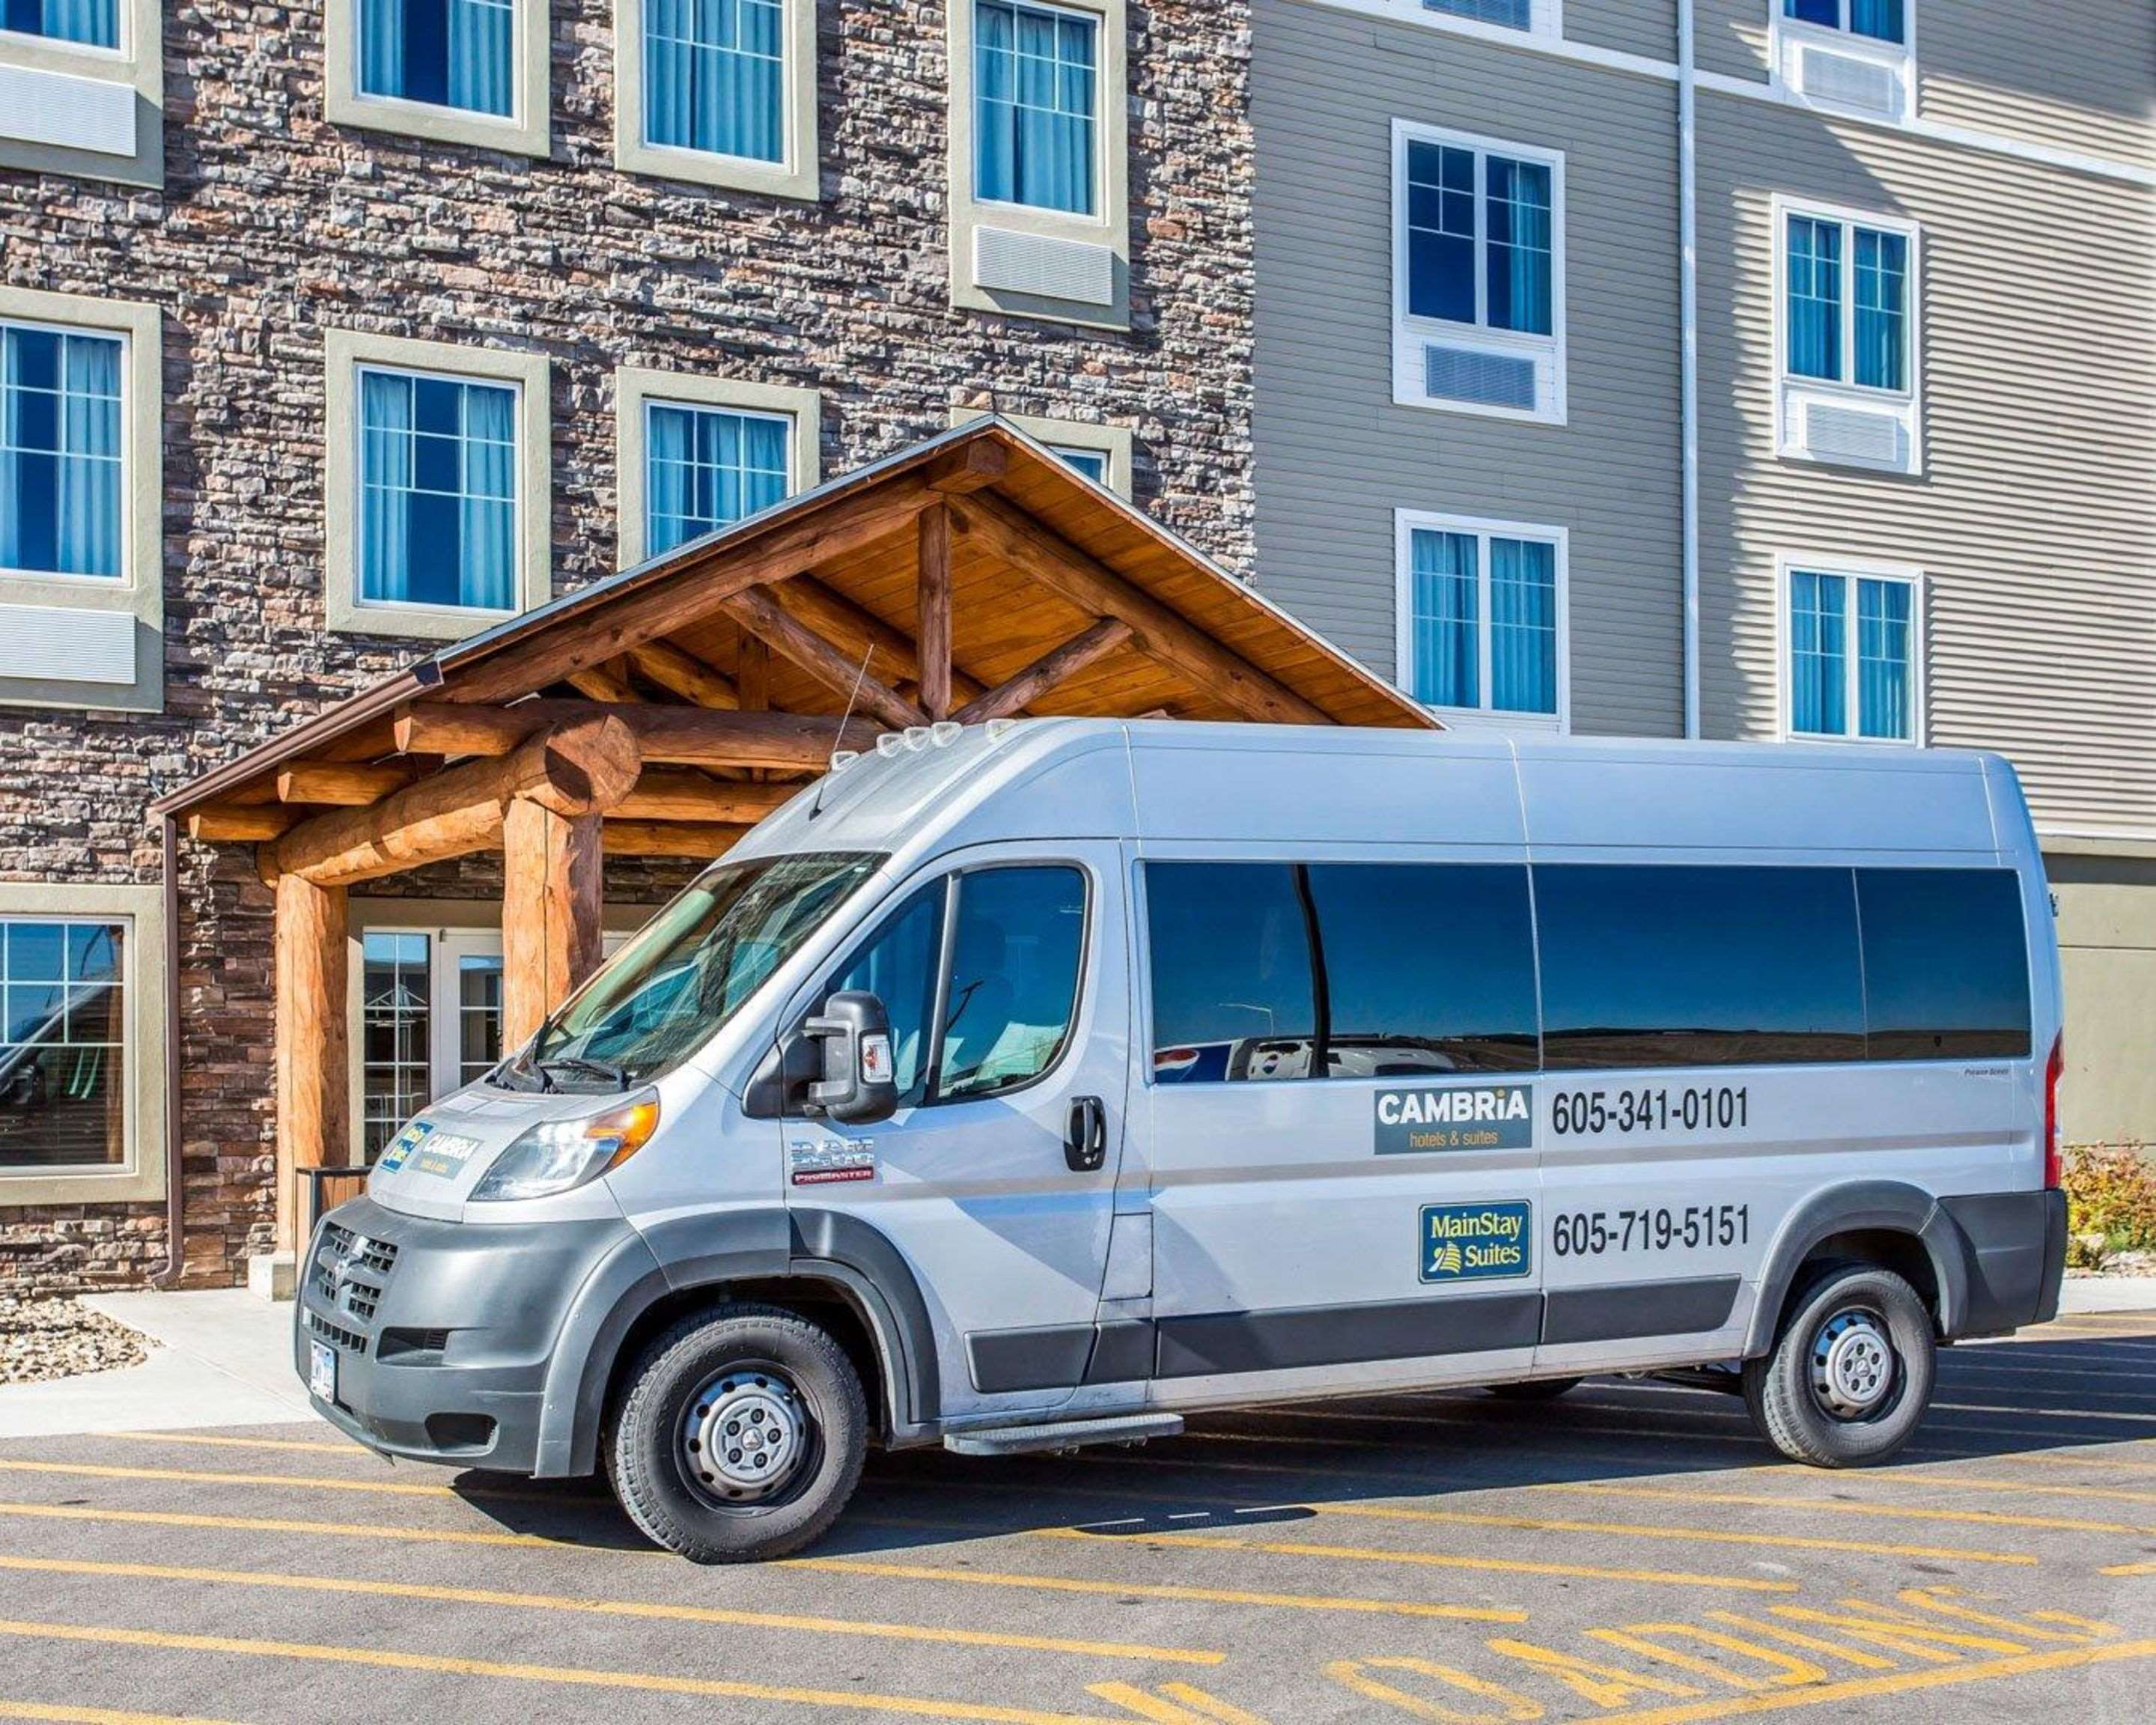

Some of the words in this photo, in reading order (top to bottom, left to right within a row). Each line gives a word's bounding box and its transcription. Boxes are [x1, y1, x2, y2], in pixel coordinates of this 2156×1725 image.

[1552, 1086, 1747, 1135] 605-341-0101
[1410, 1131, 1446, 1148] hotels
[1449, 1131, 1459, 1146] &
[1462, 1131, 1498, 1146] suites
[1431, 1211, 1523, 1242] MainStay
[1553, 1204, 1749, 1256] 605-719-5151
[1464, 1242, 1520, 1268] Suites
